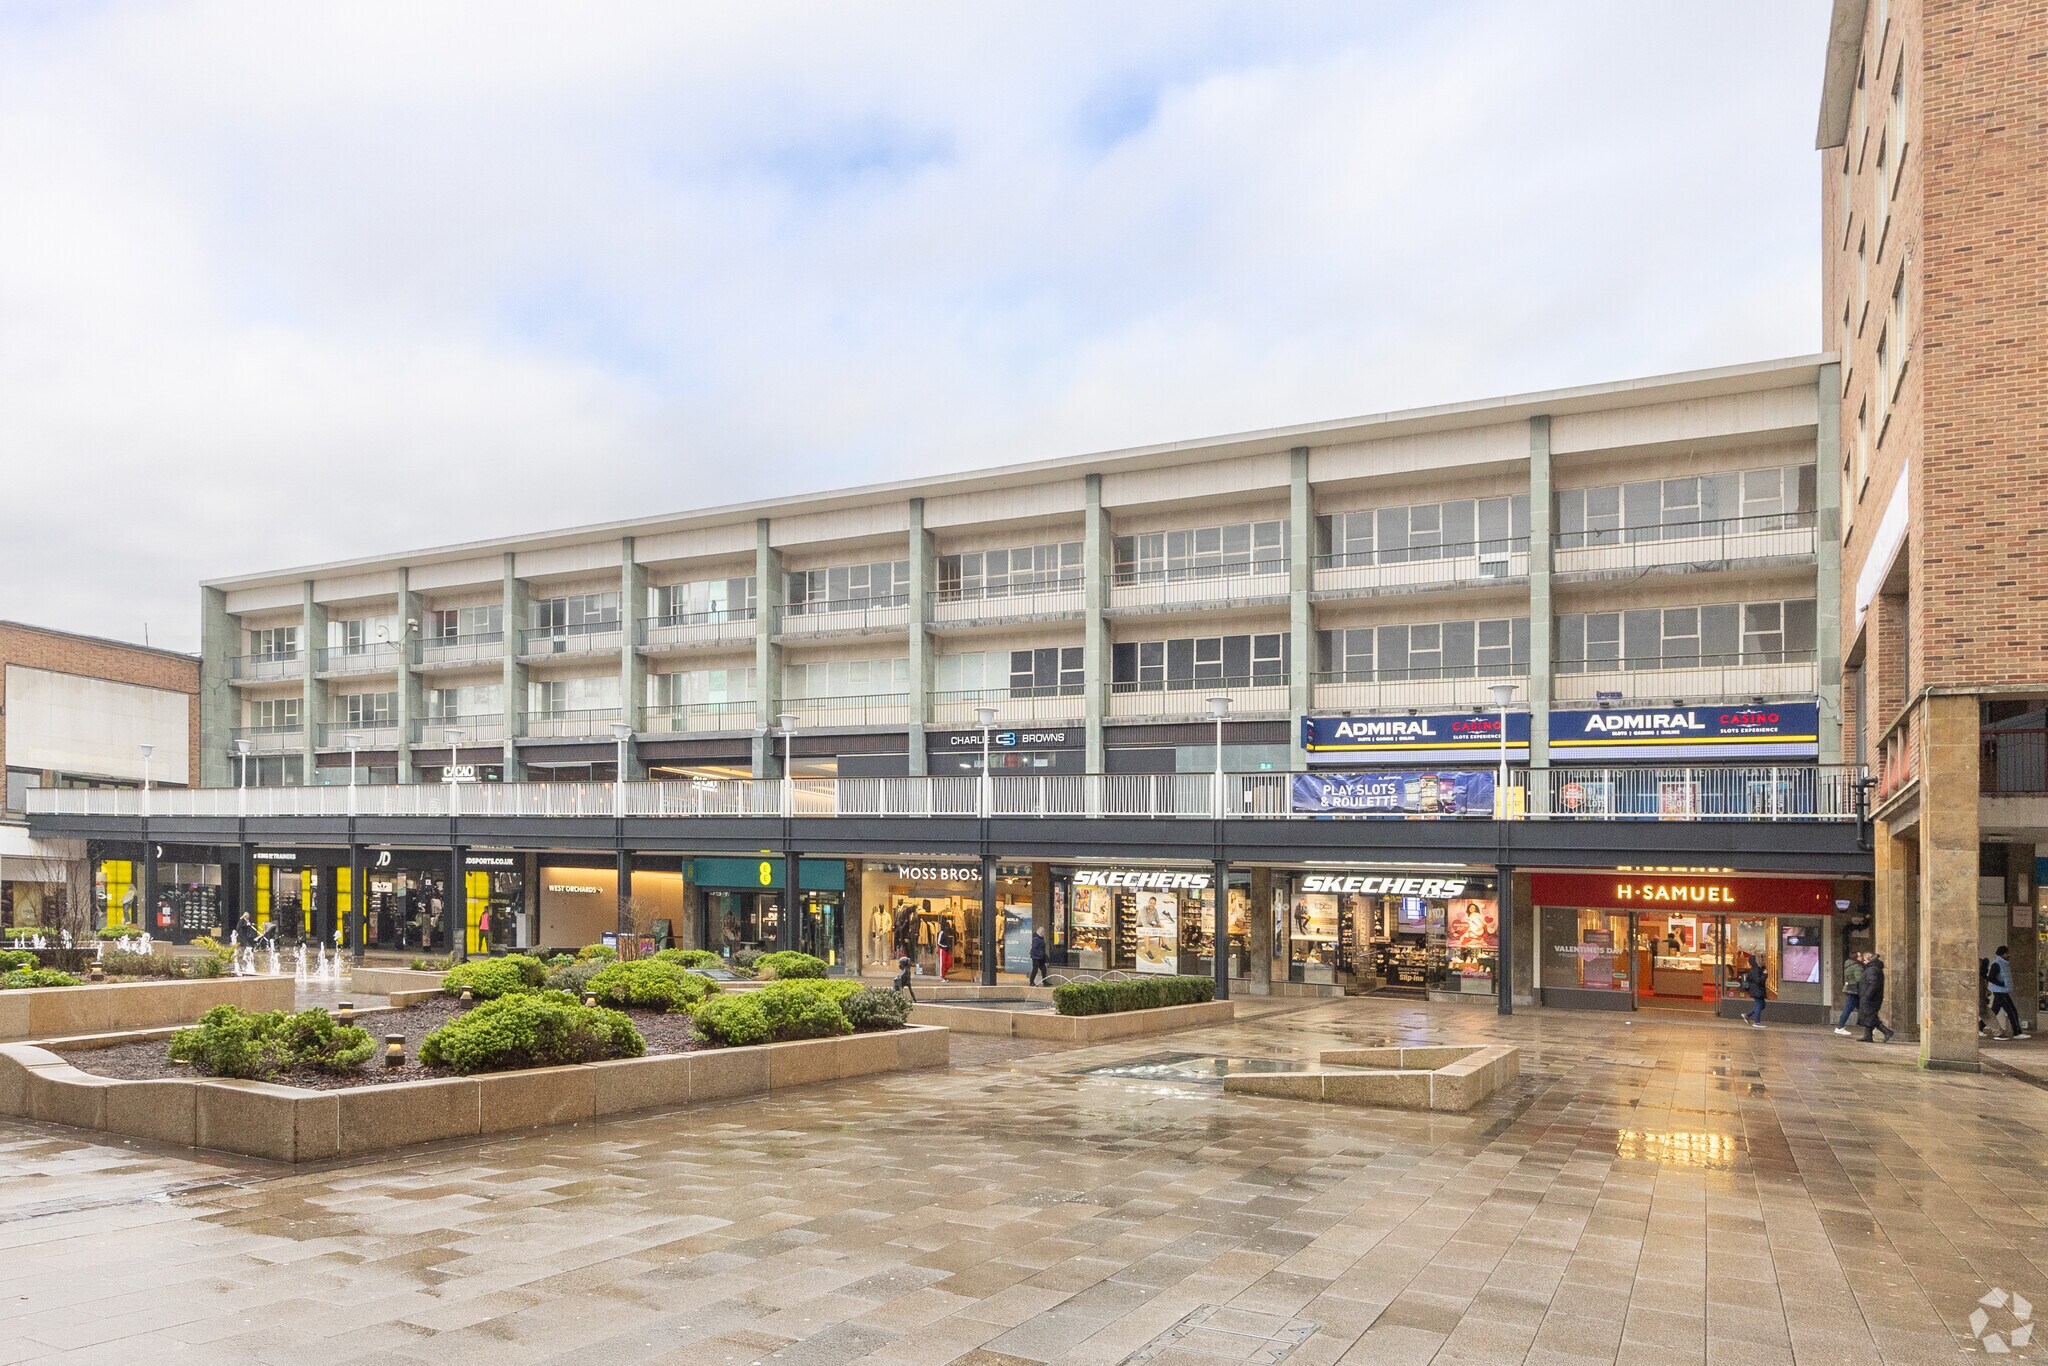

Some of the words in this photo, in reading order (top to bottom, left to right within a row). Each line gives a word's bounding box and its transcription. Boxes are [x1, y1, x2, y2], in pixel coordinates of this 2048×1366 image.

[1585, 712, 1705, 731] ADMIRAL
[1719, 713, 1779, 724] CASINO
[1335, 720, 1436, 737] ADMIRAL
[1452, 721, 1501, 731] CASINO
[1022, 733, 1065, 743] BROWNS
[1323, 785, 1355, 796] PLAY
[1357, 783, 1396, 795] SLOTS
[1320, 796, 1329, 807] &
[1333, 794, 1398, 807] ROULETTE
[376, 851, 391, 866] JD
[900, 867, 936, 880] MOSS
[940, 868, 982, 880] BROS.
[1073, 870, 1210, 889] SKECHERS
[1301, 875, 1466, 896] SKECHERS
